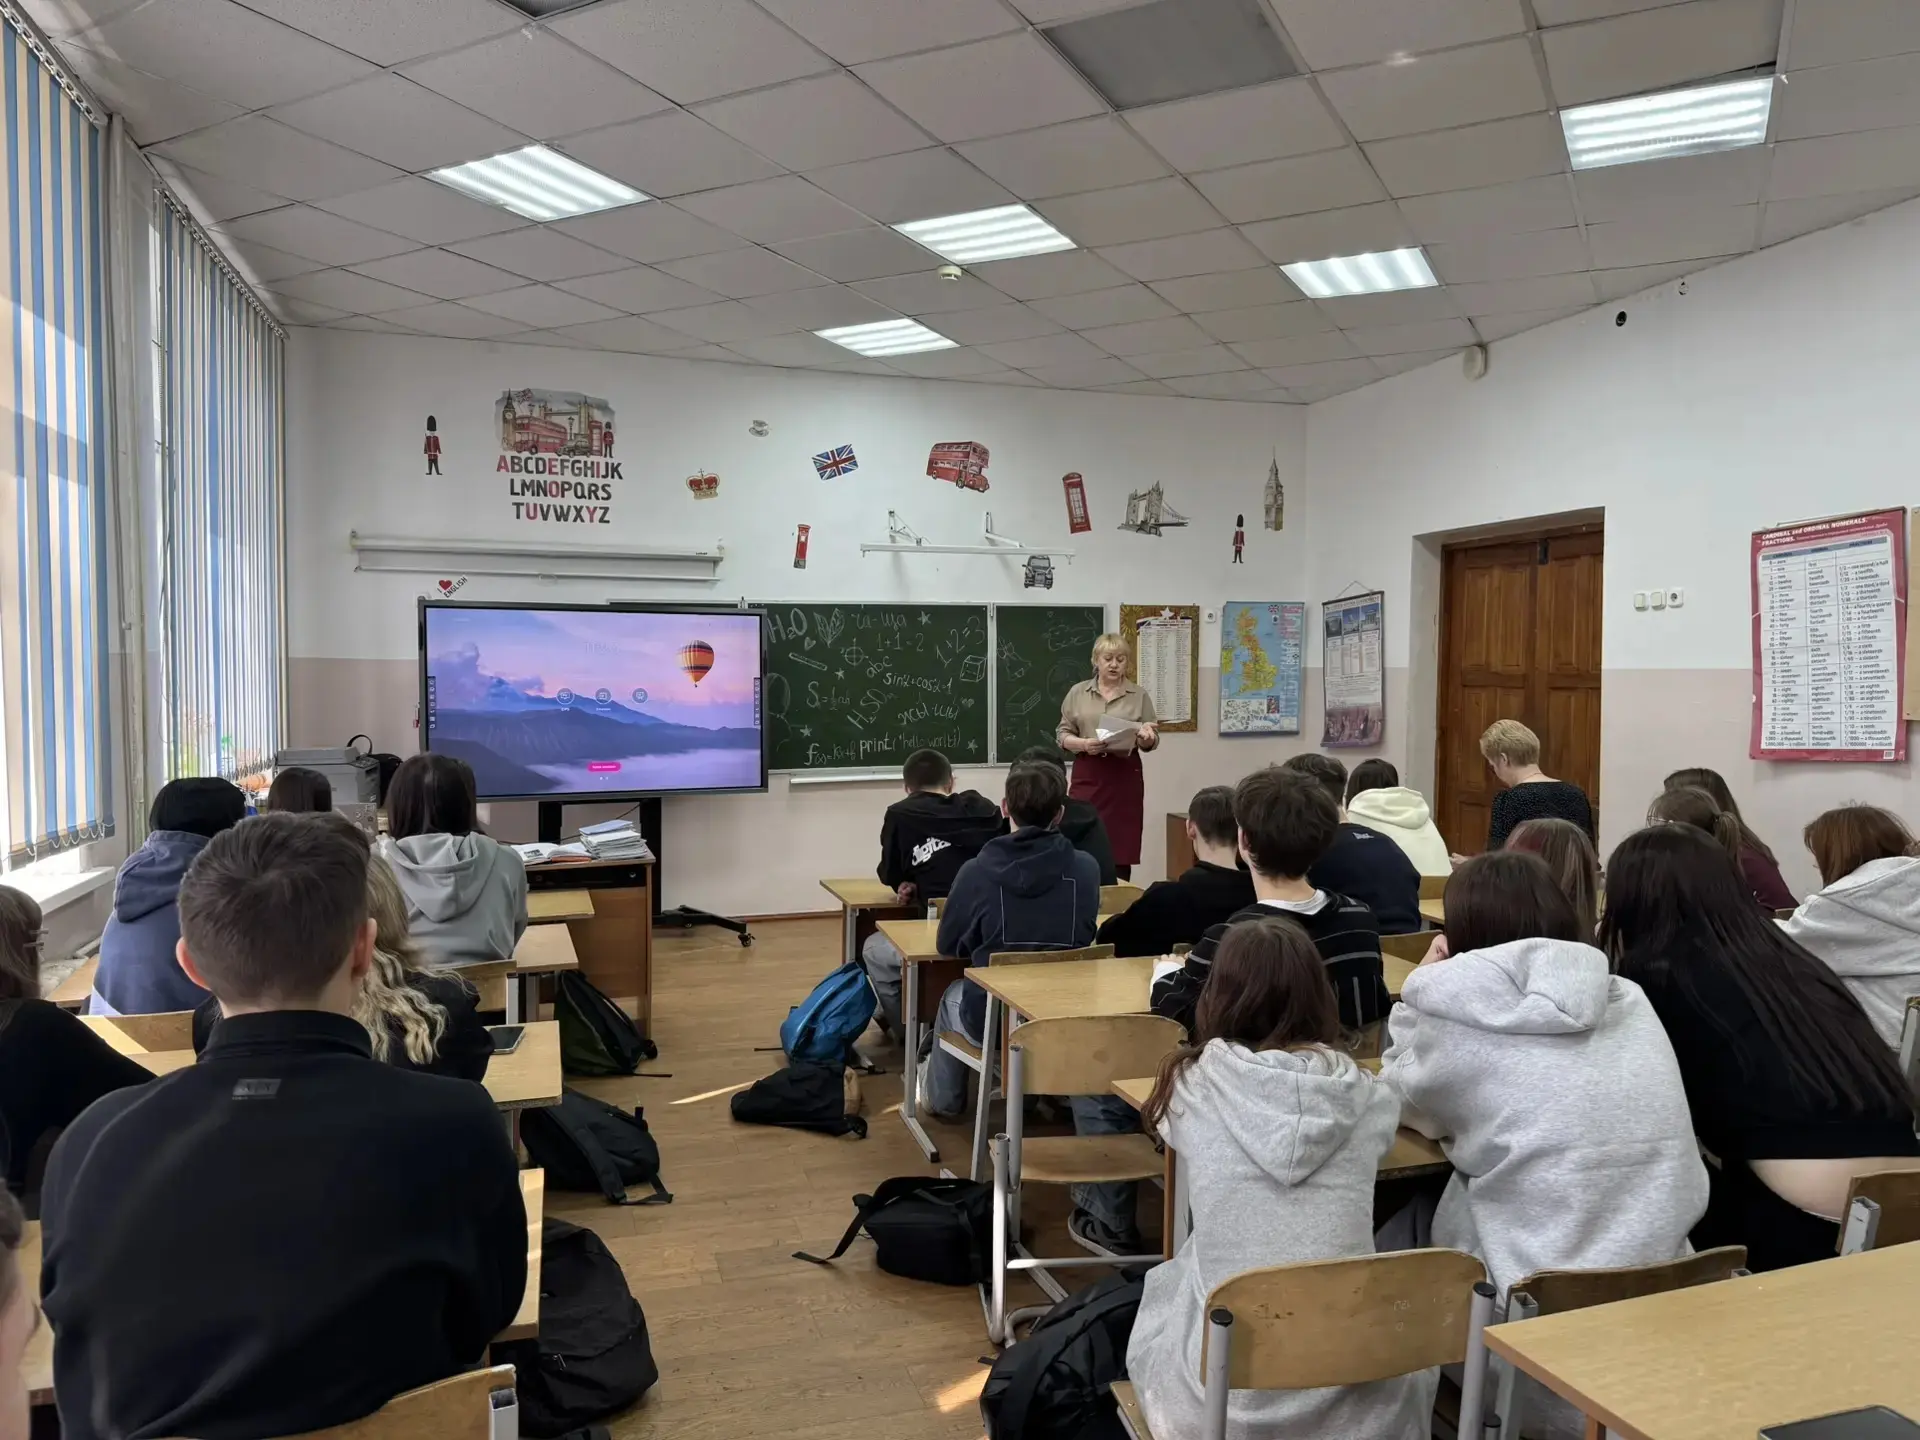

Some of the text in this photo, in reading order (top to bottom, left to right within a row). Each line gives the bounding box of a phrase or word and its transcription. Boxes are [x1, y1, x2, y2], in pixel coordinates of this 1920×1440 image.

[496, 455, 624, 480] ABCDEFGHIJK
[510, 478, 612, 501] LMNOPQRS
[511, 502, 610, 524] TUVWXYZ
[443, 576, 468, 598] ENGLISH
[867, 655, 893, 678] abc
